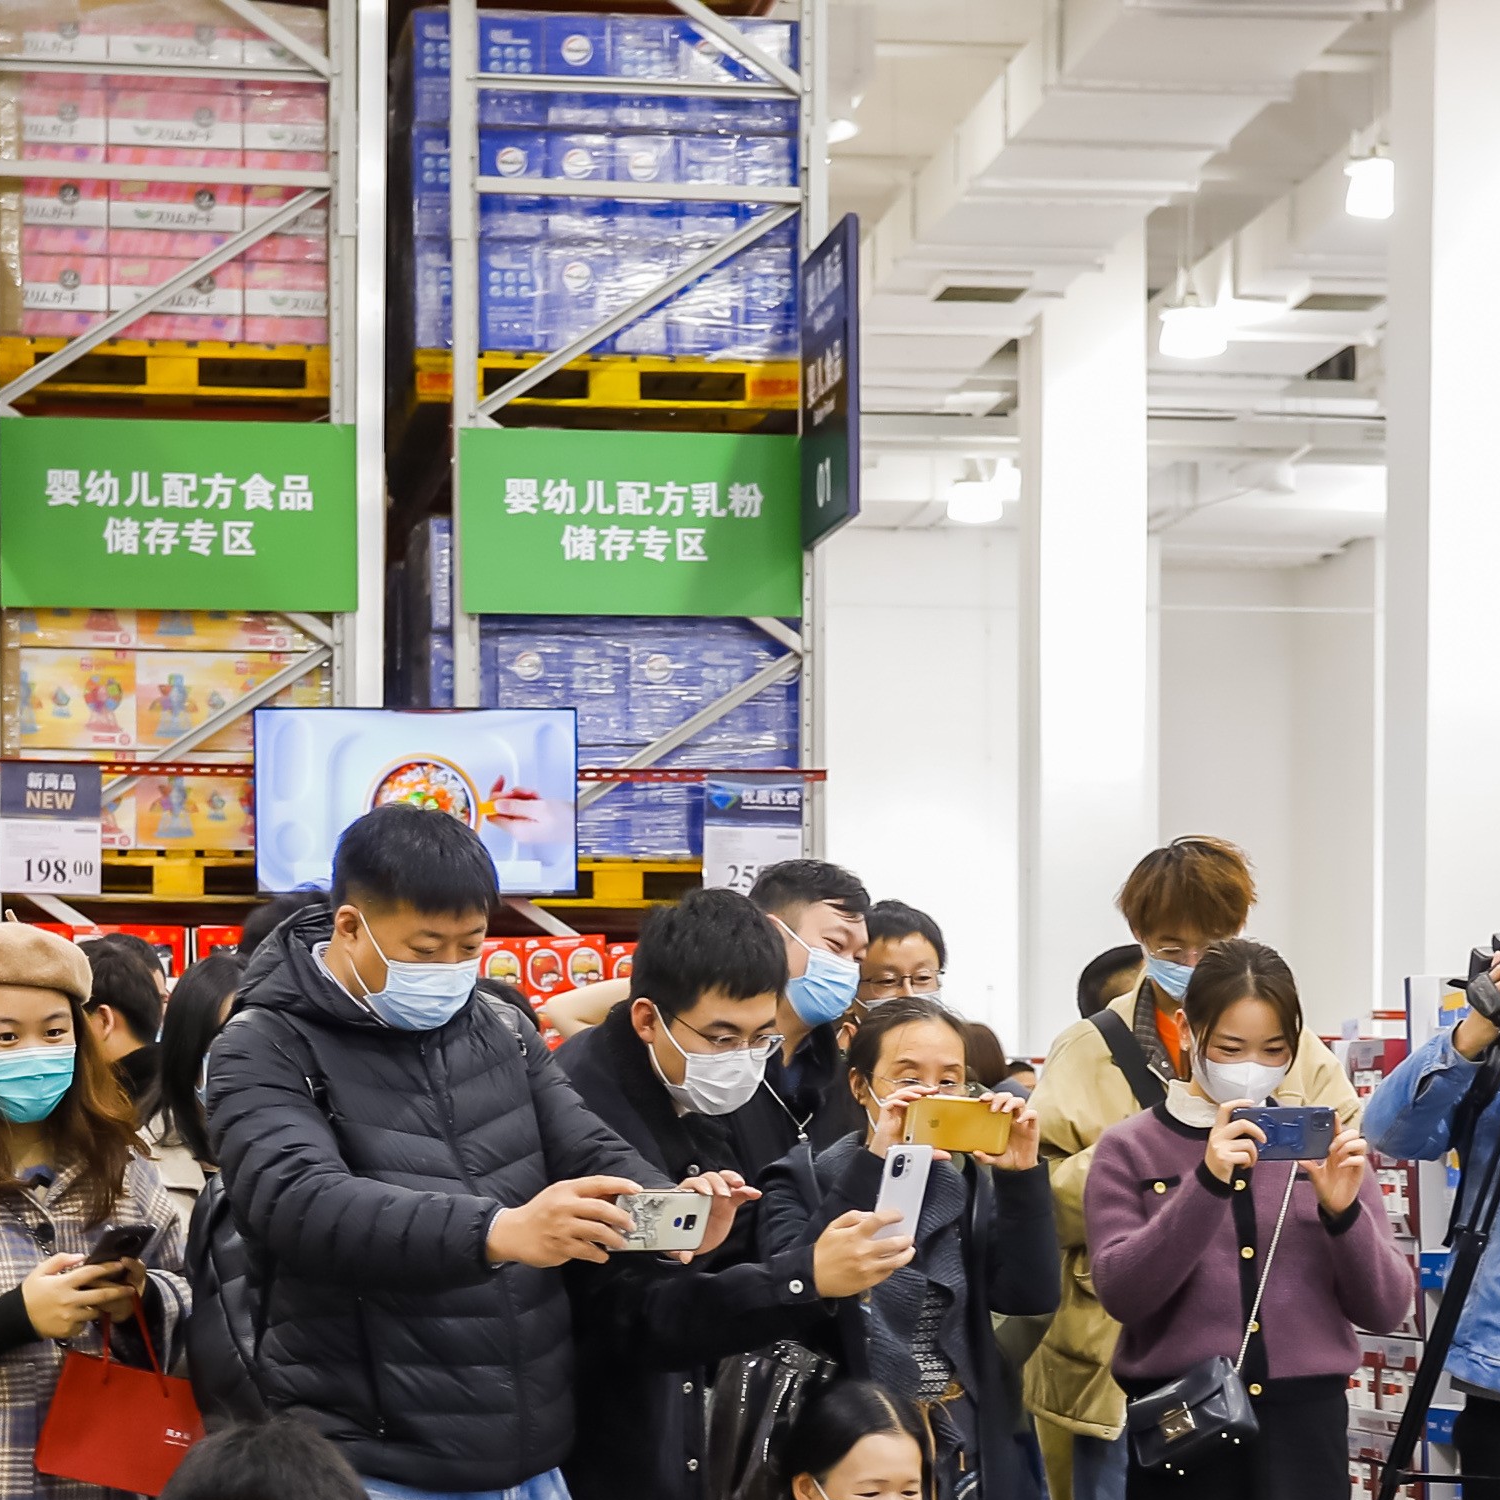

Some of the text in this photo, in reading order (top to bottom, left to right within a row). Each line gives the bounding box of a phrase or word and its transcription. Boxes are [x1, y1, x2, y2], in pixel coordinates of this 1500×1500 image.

[45, 467, 314, 512] 婴幼儿配方食品
[503, 477, 764, 521] 婴幼儿配方乳粉
[816, 456, 832, 508] 01
[103, 517, 257, 558] 储存专区
[560, 523, 710, 564] 储存专区
[25, 790, 76, 811] NEW
[26, 772, 77, 790] 新商品
[23, 857, 94, 885] 198.00
